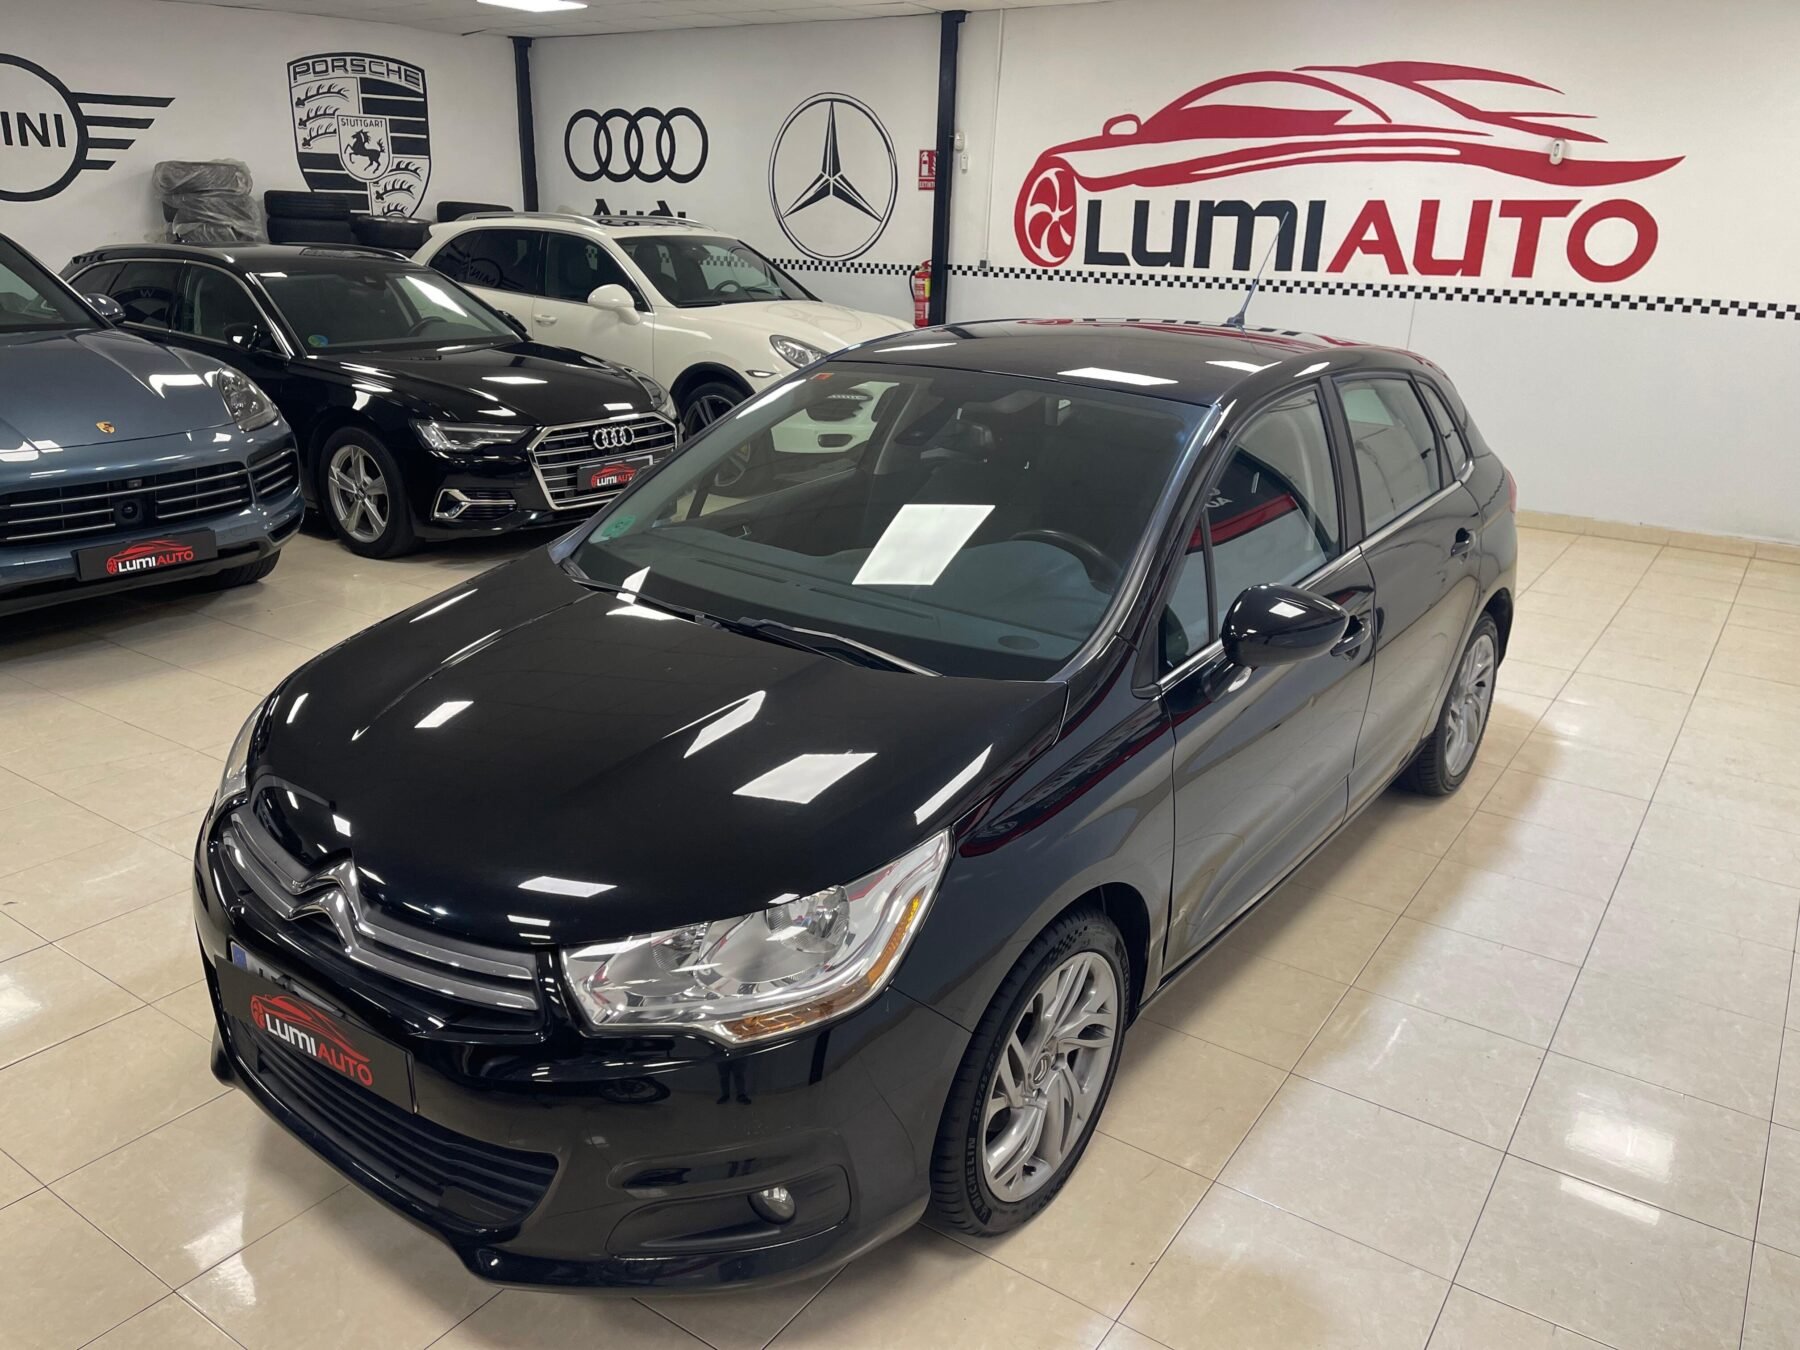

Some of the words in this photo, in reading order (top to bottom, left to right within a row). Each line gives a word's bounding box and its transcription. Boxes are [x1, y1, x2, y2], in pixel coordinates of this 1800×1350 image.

[292, 57, 422, 88] PORSCHE
[0, 111, 66, 148] INI
[340, 117, 384, 129] STUTTGART
[1084, 198, 1659, 284] LUMIAUTO
[596, 472, 635, 487] LUMIAUT
[118, 551, 194, 573] LUMIAUTO
[265, 1012, 374, 1087] LUMIAUTO
[967, 1137, 985, 1210] MICHELIN
